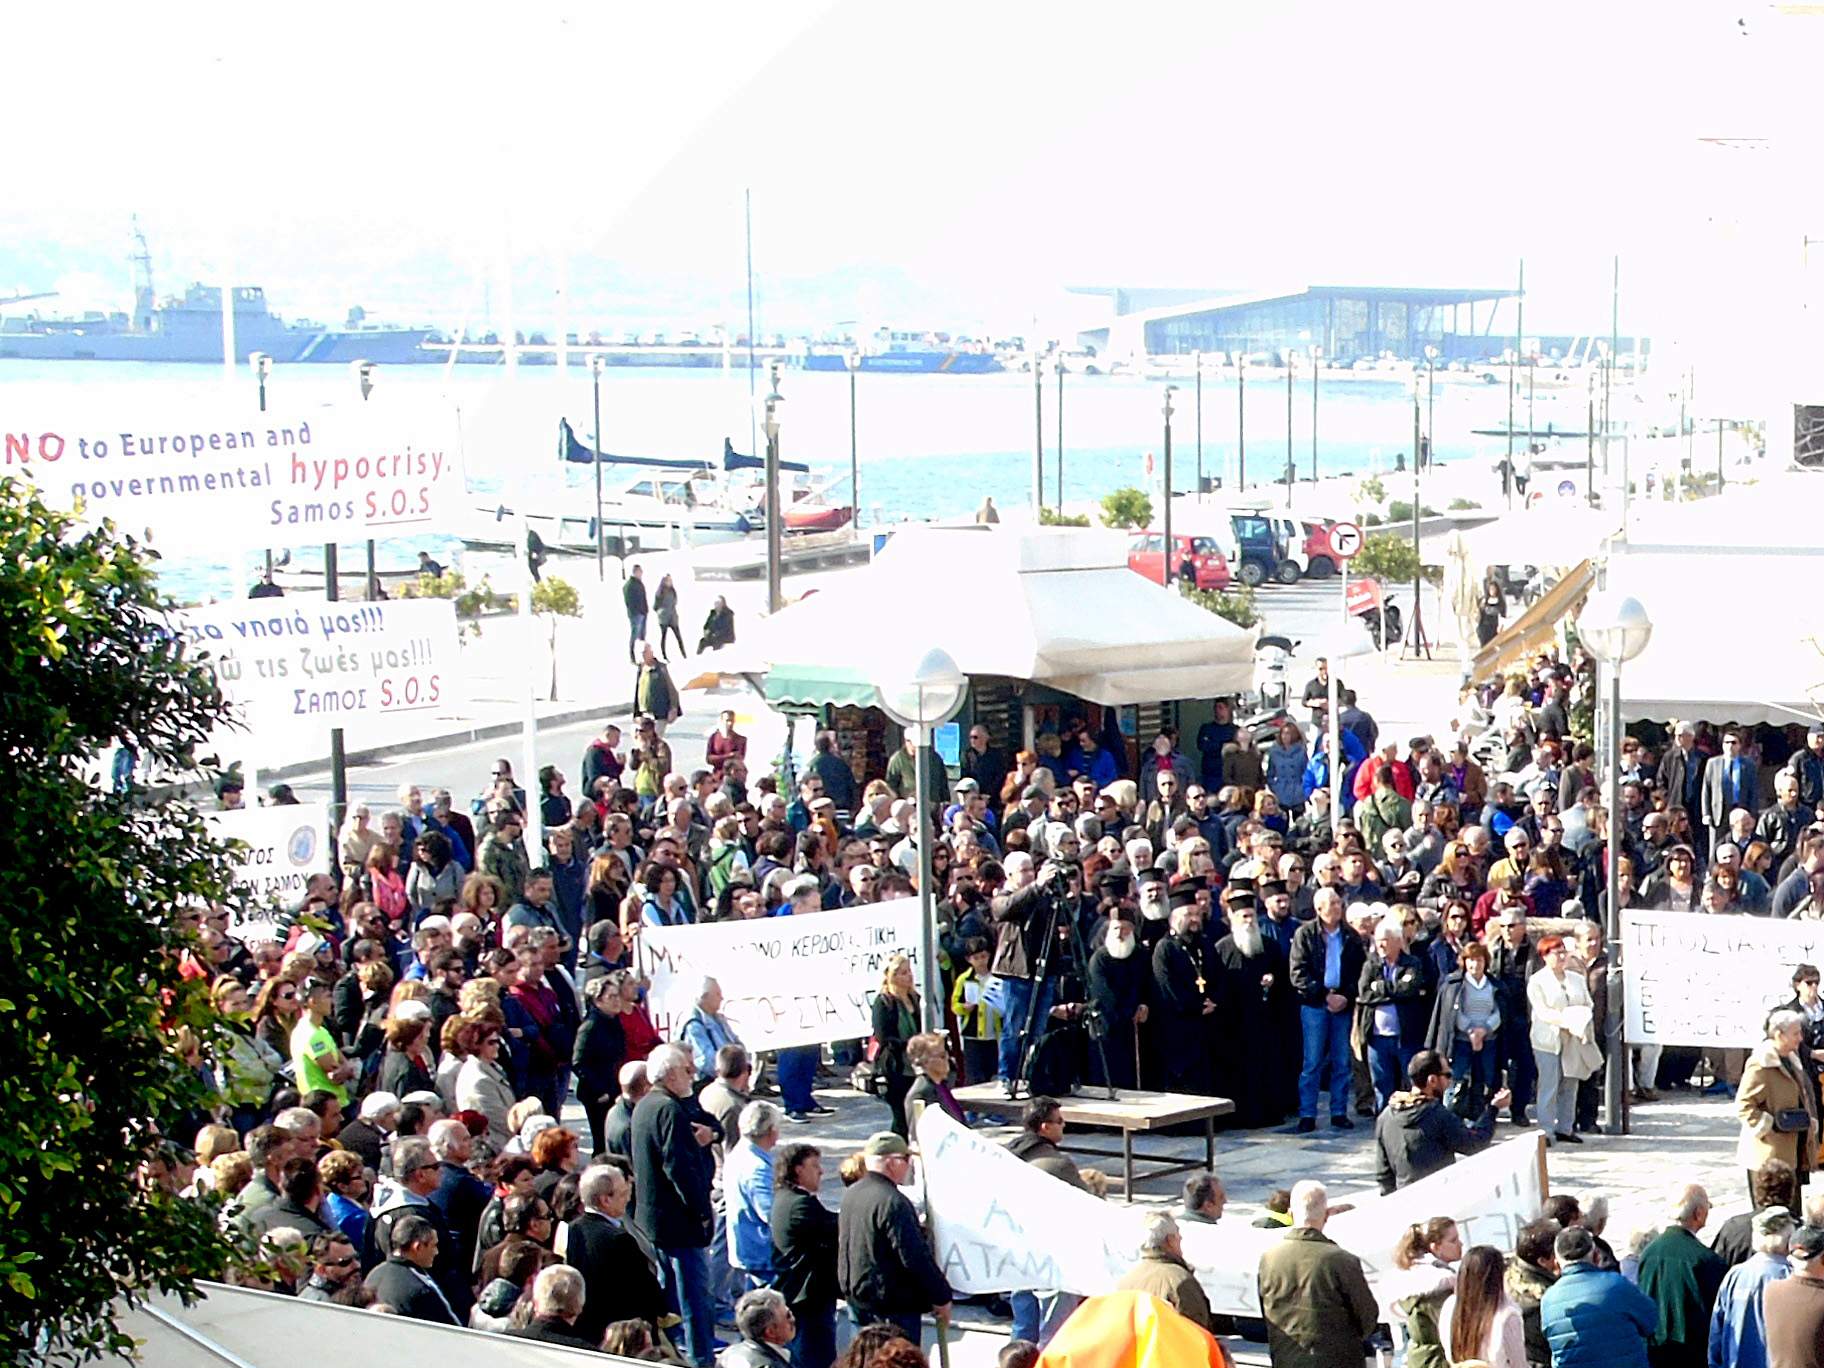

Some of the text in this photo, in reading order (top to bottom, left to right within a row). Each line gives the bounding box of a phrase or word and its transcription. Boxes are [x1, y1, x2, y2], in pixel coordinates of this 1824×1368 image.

[5, 422, 312, 464] NO to European and
[71, 446, 451, 502] governmental hypocrisy.
[270, 498, 355, 526] Samos
